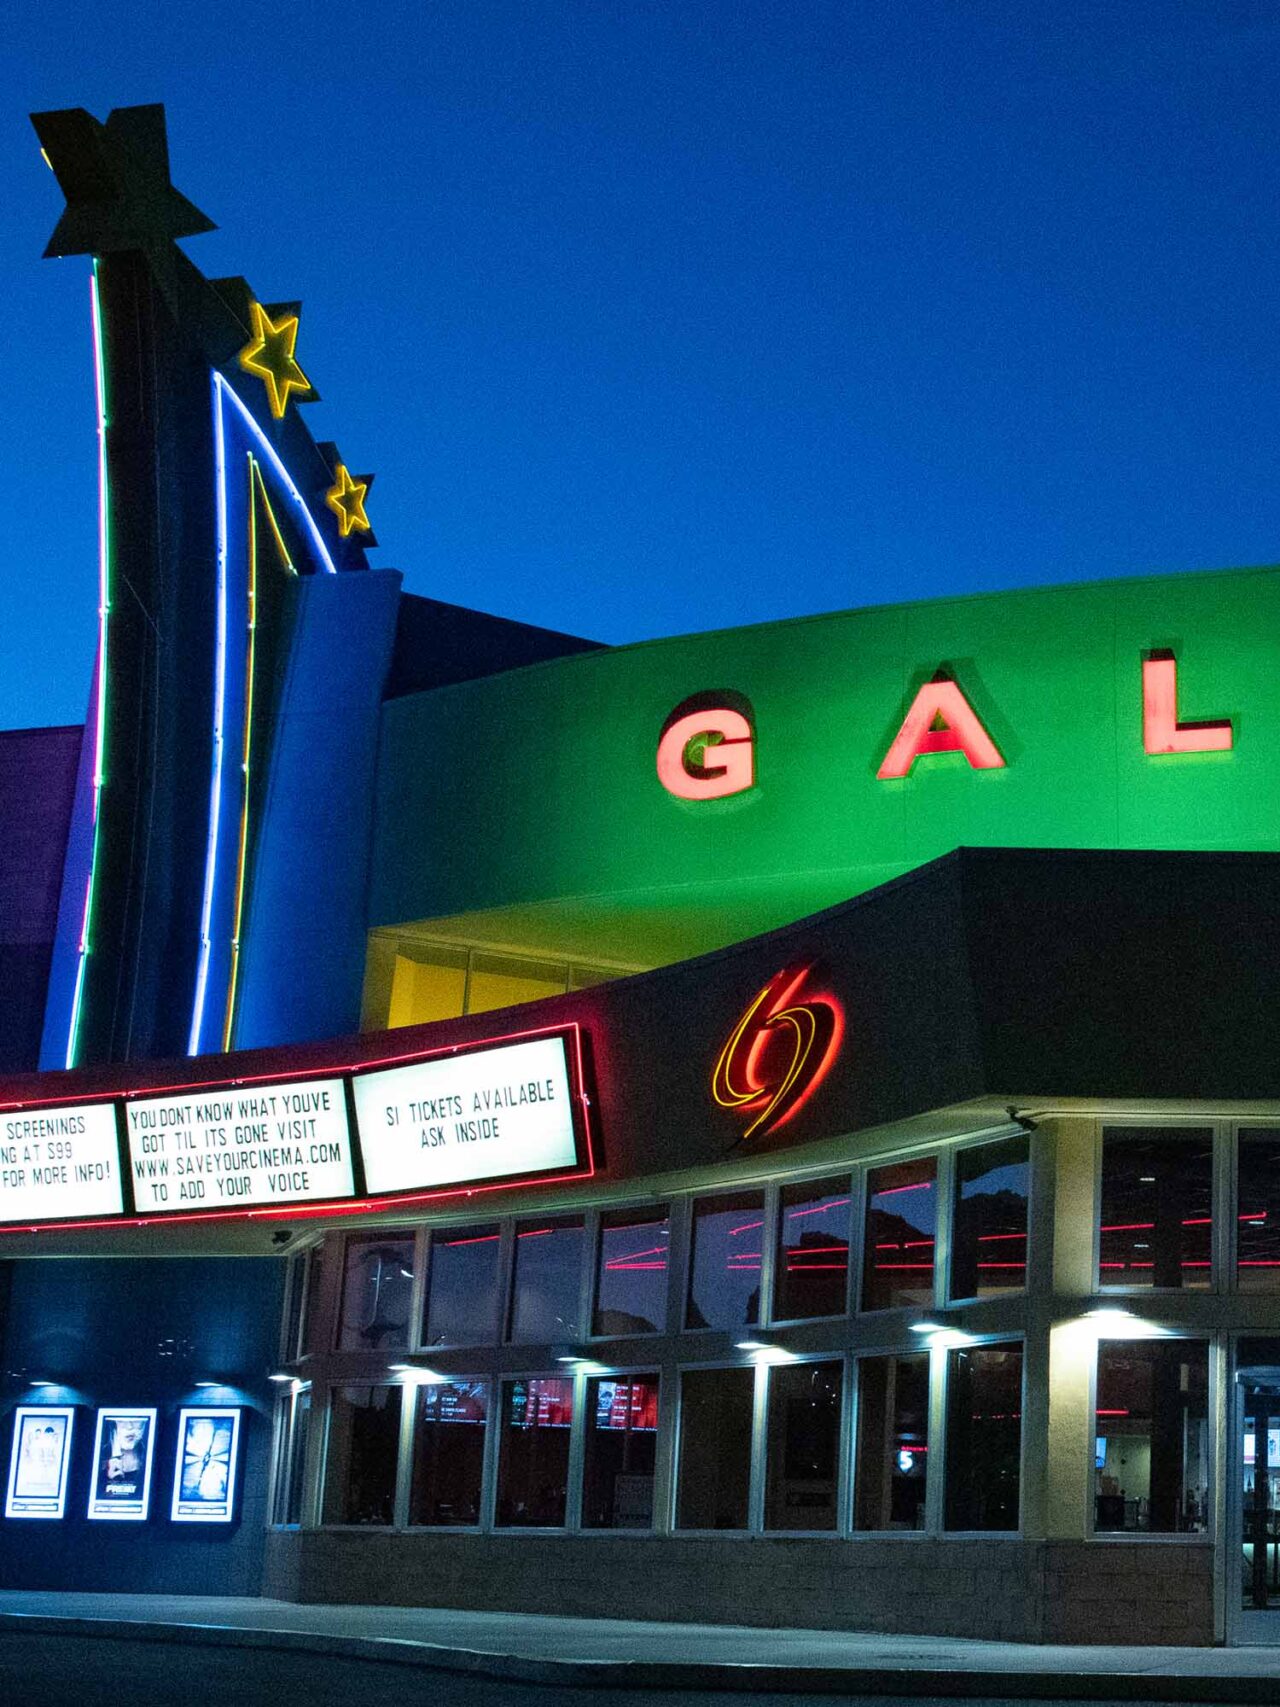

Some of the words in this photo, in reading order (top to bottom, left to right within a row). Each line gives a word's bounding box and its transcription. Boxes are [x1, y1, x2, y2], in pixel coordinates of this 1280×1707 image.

[131, 1111, 156, 1129] YOU
[160, 1106, 192, 1127] DONT
[197, 1102, 233, 1123] KNOW
[238, 1097, 277, 1118] WHAT
[282, 1092, 330, 1114] YOUVE
[409, 1096, 463, 1123] TICKETS
[473, 1080, 555, 1112] AVAILABLE
[7, 1116, 86, 1140] SCREENINGS
[142, 1134, 165, 1153] GOT
[175, 1131, 197, 1150] TIL
[205, 1128, 227, 1147] ITS
[235, 1124, 269, 1144] GONE
[278, 1119, 316, 1140] VISIT
[421, 1126, 446, 1148] ASK
[455, 1118, 500, 1143] INSIDE
[24, 1145, 39, 1162] AT
[135, 1143, 341, 1178] WWW.SAVEYOURCINEMA.COM
[2, 1170, 25, 1188] FOR
[33, 1166, 68, 1184] MORE
[75, 1160, 110, 1182] INFO!
[152, 1184, 168, 1202] TO
[180, 1180, 205, 1200] ADD
[217, 1176, 252, 1196] YOUR
[268, 1172, 309, 1192] VOICE
